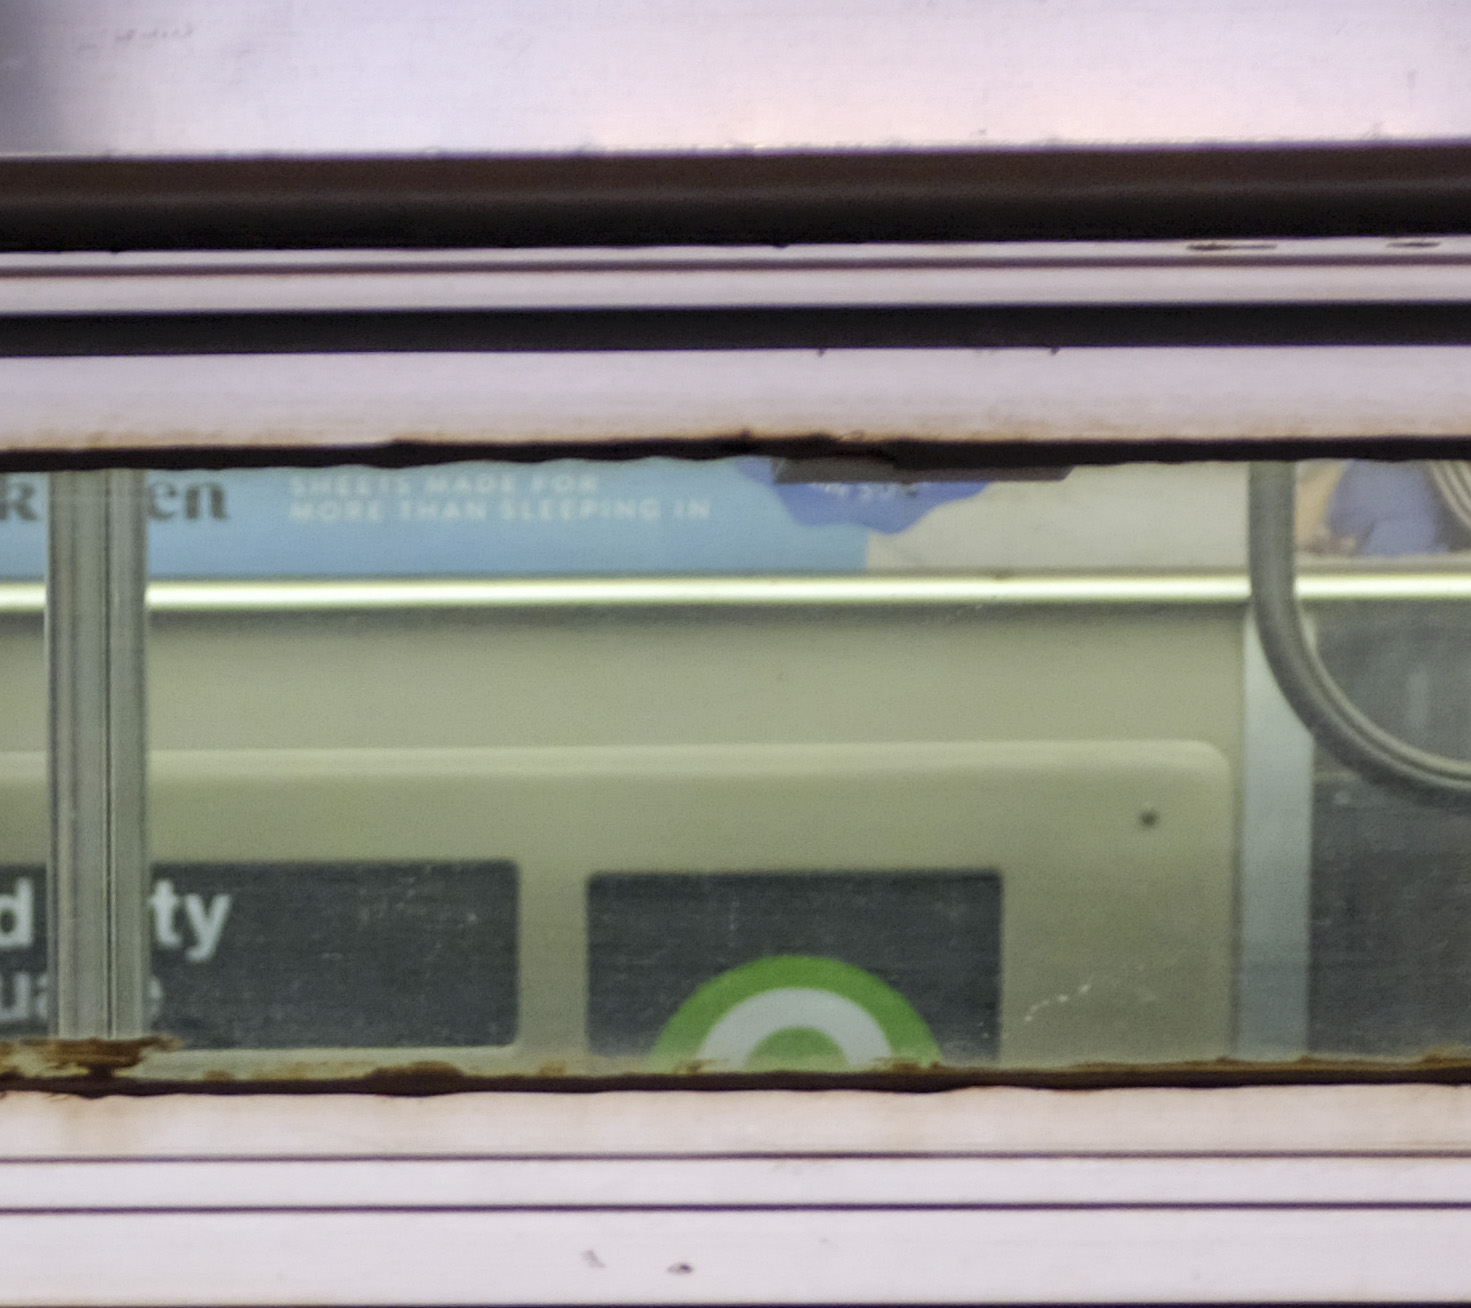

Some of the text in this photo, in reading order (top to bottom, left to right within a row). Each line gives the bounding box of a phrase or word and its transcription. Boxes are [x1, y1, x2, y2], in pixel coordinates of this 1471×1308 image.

[289, 473, 599, 496] SHEETS MADE FOR
[289, 498, 711, 522] MORE THAN SLEEPING IN
